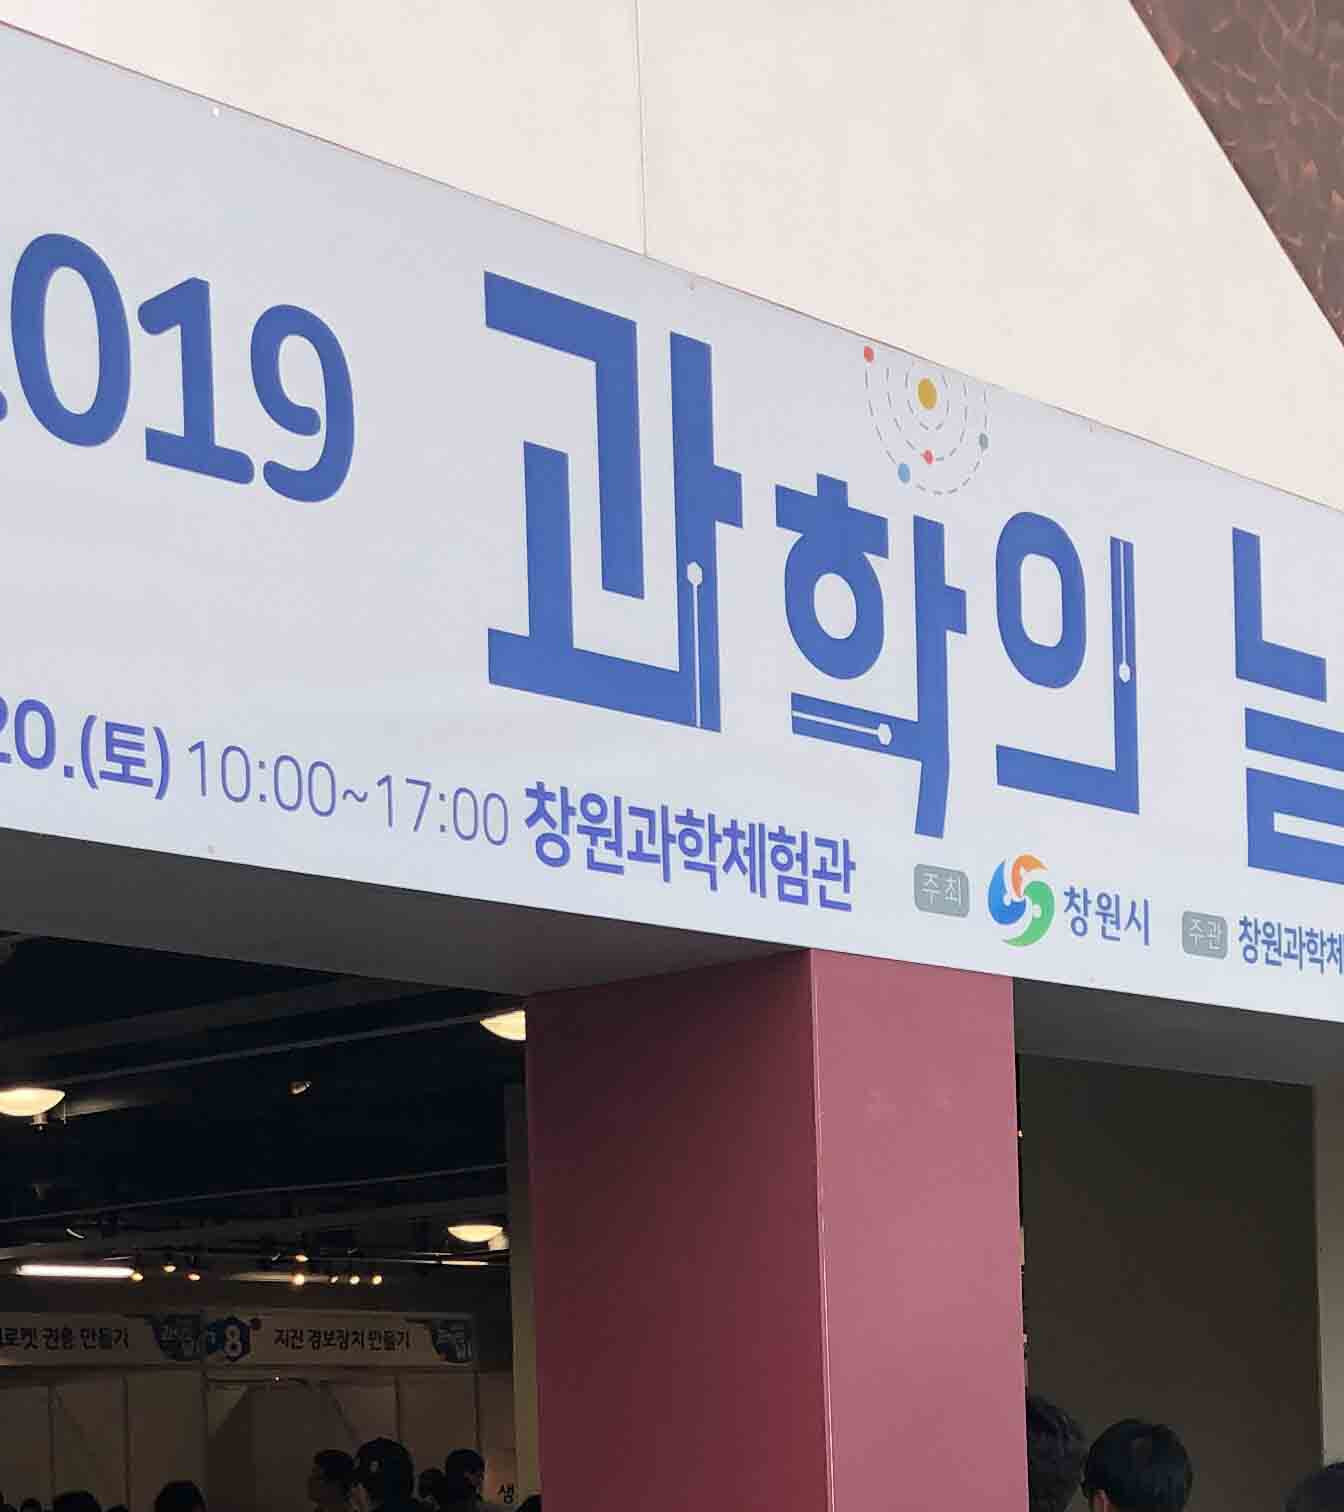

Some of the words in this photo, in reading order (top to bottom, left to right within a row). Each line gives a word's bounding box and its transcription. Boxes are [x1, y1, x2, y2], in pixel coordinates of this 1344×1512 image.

[484, 271, 1140, 839] 과학의
[188, 740, 510, 847] 10:00~17:00
[524, 781, 856, 912] 창원과학체험관
[918, 870, 963, 912] 주최
[1063, 885, 1151, 946] 창원시
[1187, 917, 1224, 951] 주관
[223, 1322, 244, 1361] 8
